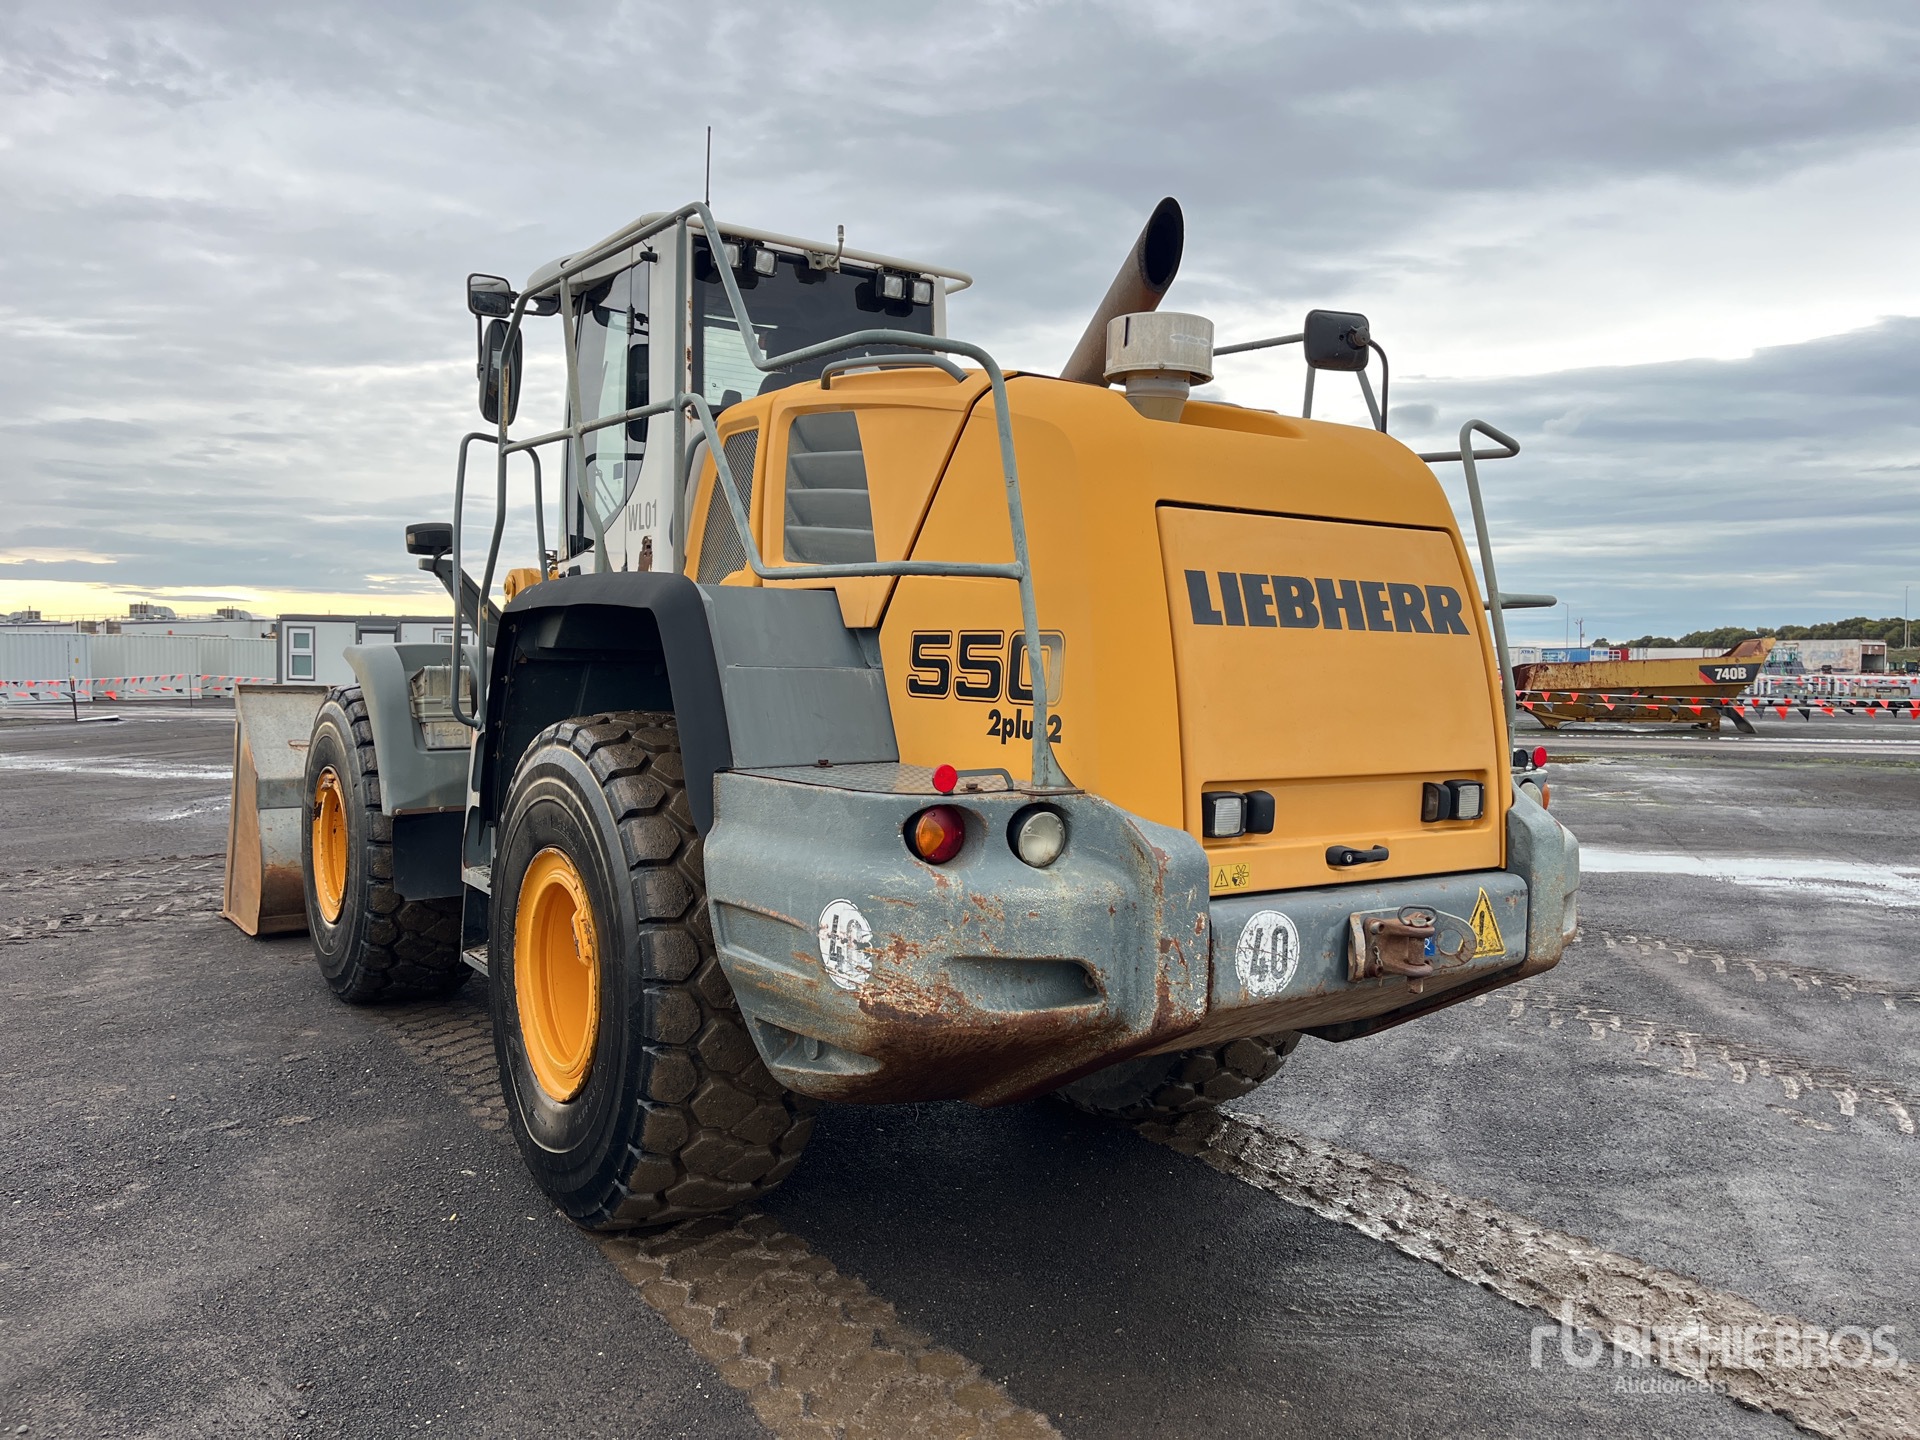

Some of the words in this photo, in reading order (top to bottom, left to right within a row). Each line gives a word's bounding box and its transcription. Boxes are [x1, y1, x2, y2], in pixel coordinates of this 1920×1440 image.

[628, 499, 657, 532] WL01
[1184, 569, 1471, 635] LIEBHERR
[906, 630, 1066, 707] 550
[1714, 667, 1747, 680] 740B
[986, 708, 1062, 745] 2plu2
[1249, 925, 1289, 982] 40
